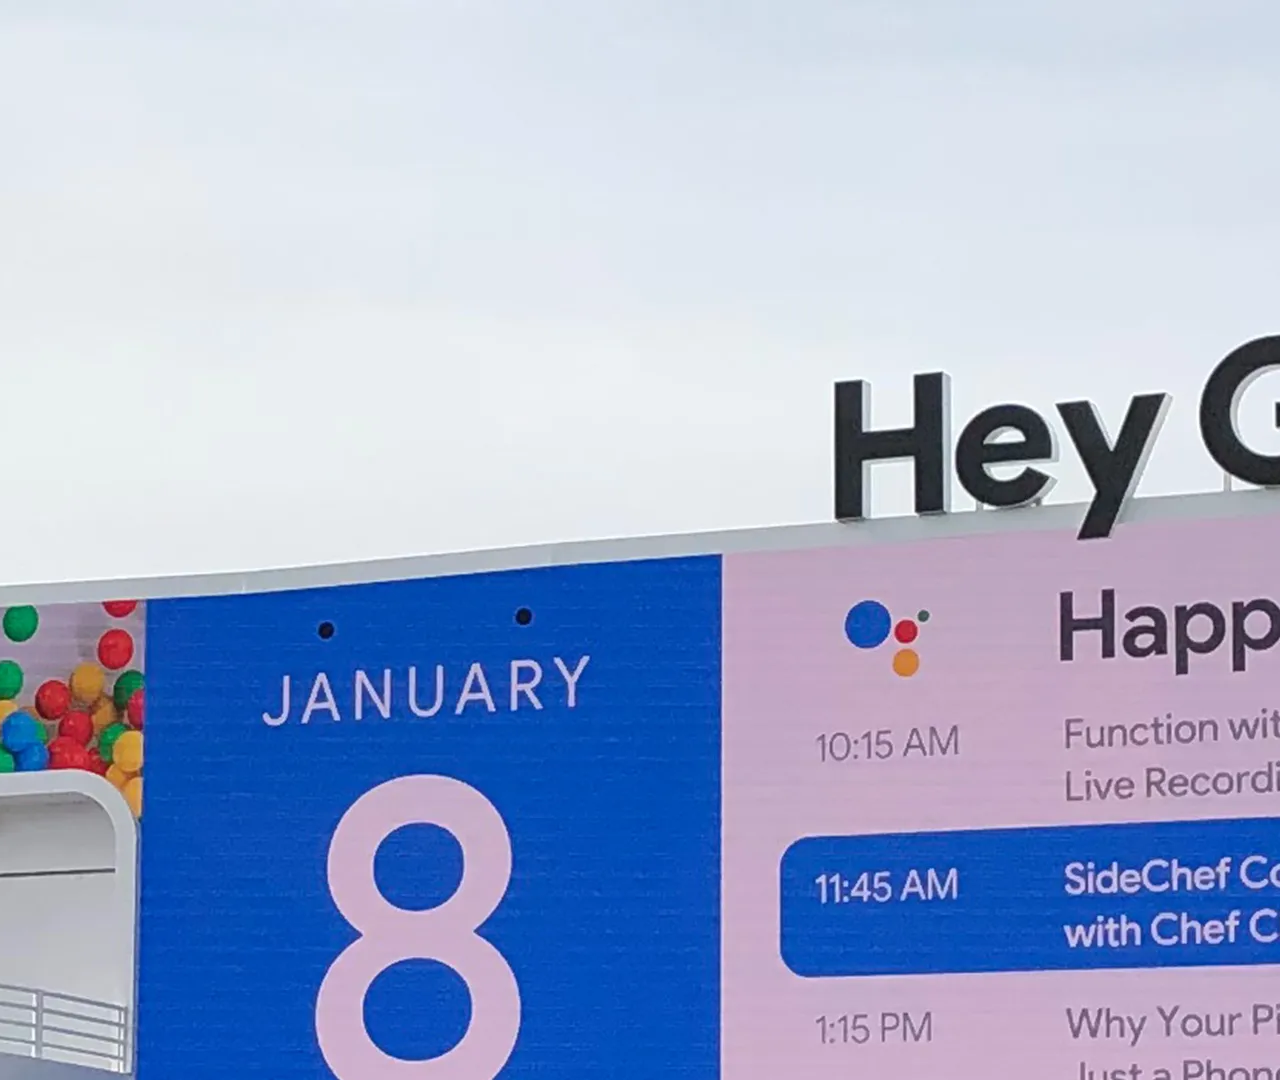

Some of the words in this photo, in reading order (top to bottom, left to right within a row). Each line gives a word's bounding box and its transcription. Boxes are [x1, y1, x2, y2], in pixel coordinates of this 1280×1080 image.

[833, 371, 1173, 541] Hey
[262, 655, 590, 727] JANUARY
[816, 729, 894, 763] 10:15
[902, 724, 960, 758] AM
[1064, 712, 1219, 749] Function
[1065, 770, 1135, 802] Live
[815, 870, 892, 904] 11:45
[900, 867, 959, 901] AM
[1064, 856, 1232, 896] SideChef
[1063, 914, 1142, 948] with
[1150, 909, 1241, 946] Chef
[815, 1013, 870, 1045] 1:15
[881, 1011, 933, 1043] PM
[1065, 1007, 1148, 1043] Why
[1156, 1005, 1243, 1038] Your
